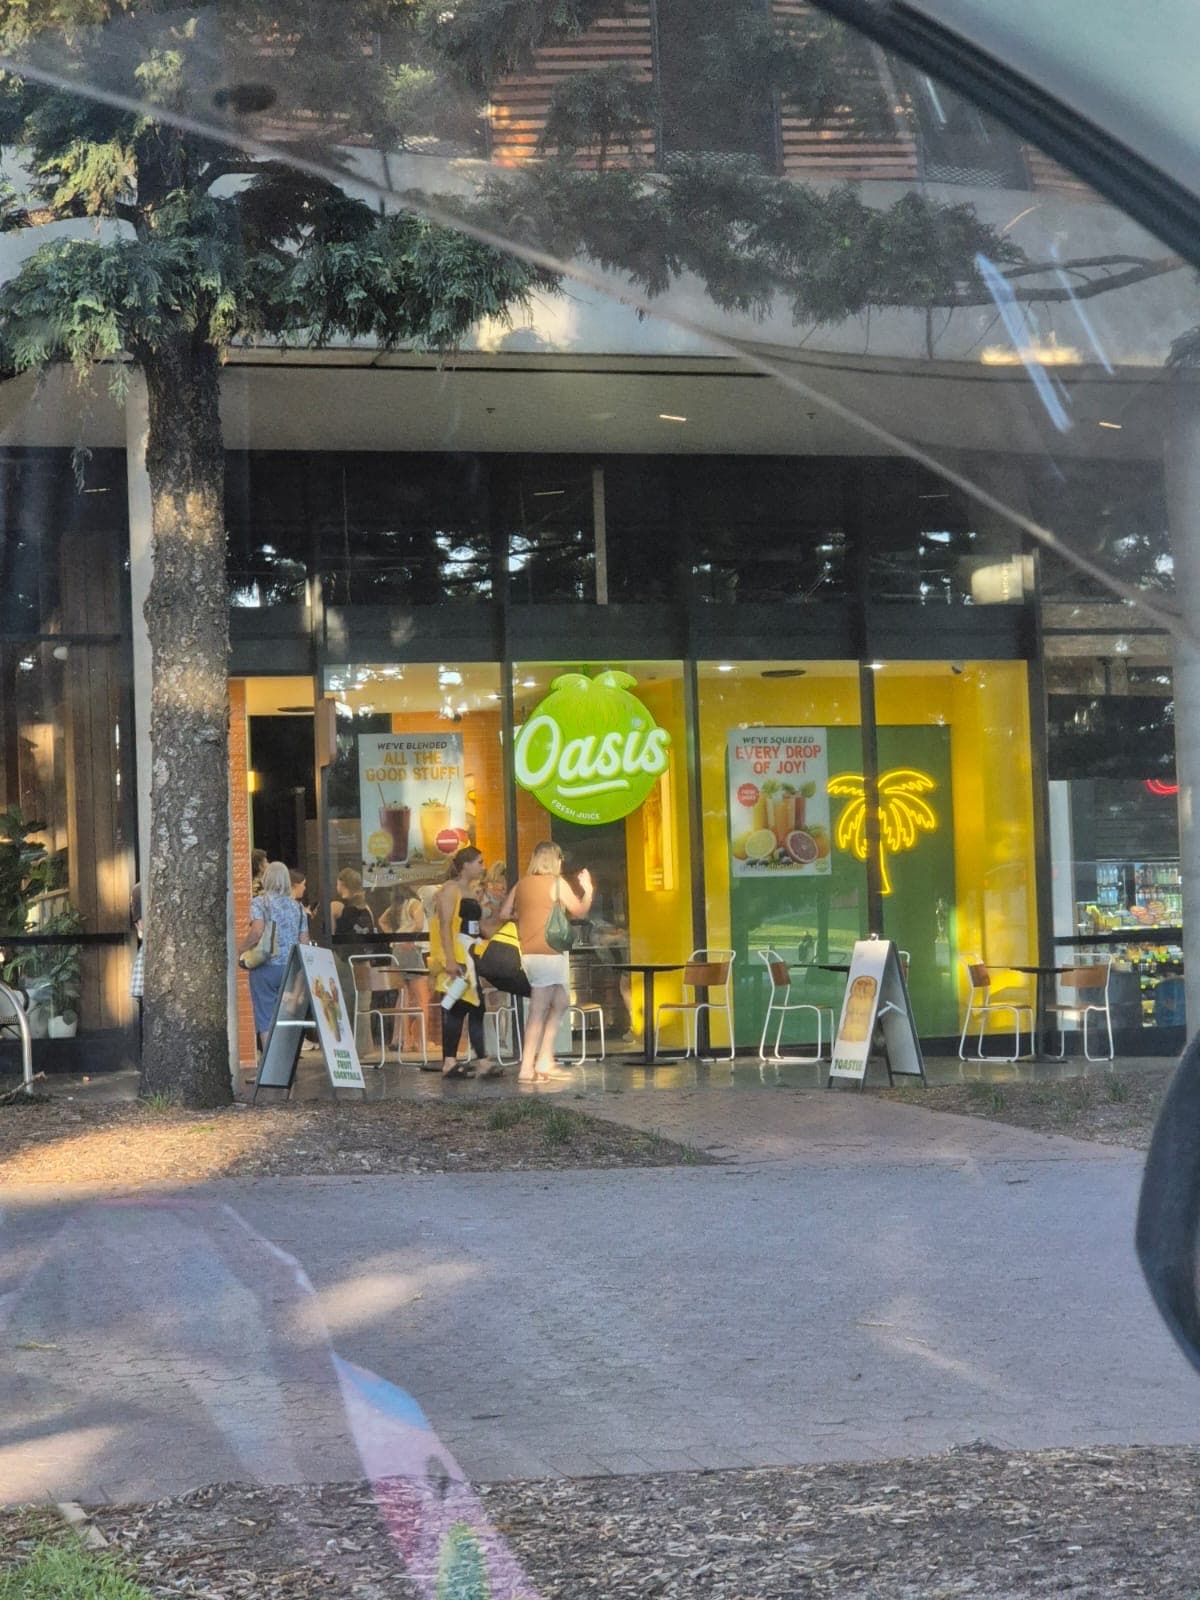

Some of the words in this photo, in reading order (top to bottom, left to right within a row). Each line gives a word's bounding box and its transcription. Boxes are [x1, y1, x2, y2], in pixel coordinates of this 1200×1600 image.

[377, 742, 404, 750] WE'VE
[406, 741, 448, 750] BLENDED
[743, 736, 769, 744] WE'VE
[770, 735, 814, 745] SQUEEZED
[384, 752, 407, 766] ALL
[414, 750, 441, 765] THE
[514, 715, 668, 787] Oasis
[735, 745, 780, 759] EVERY
[786, 744, 821, 758] DROP
[365, 768, 408, 782] GOOD
[413, 766, 460, 781] STUFF!
[753, 761, 770, 774] OF
[776, 761, 806, 774] JOY!
[551, 799, 576, 816] FRESH
[576, 811, 600, 820] JUICE
